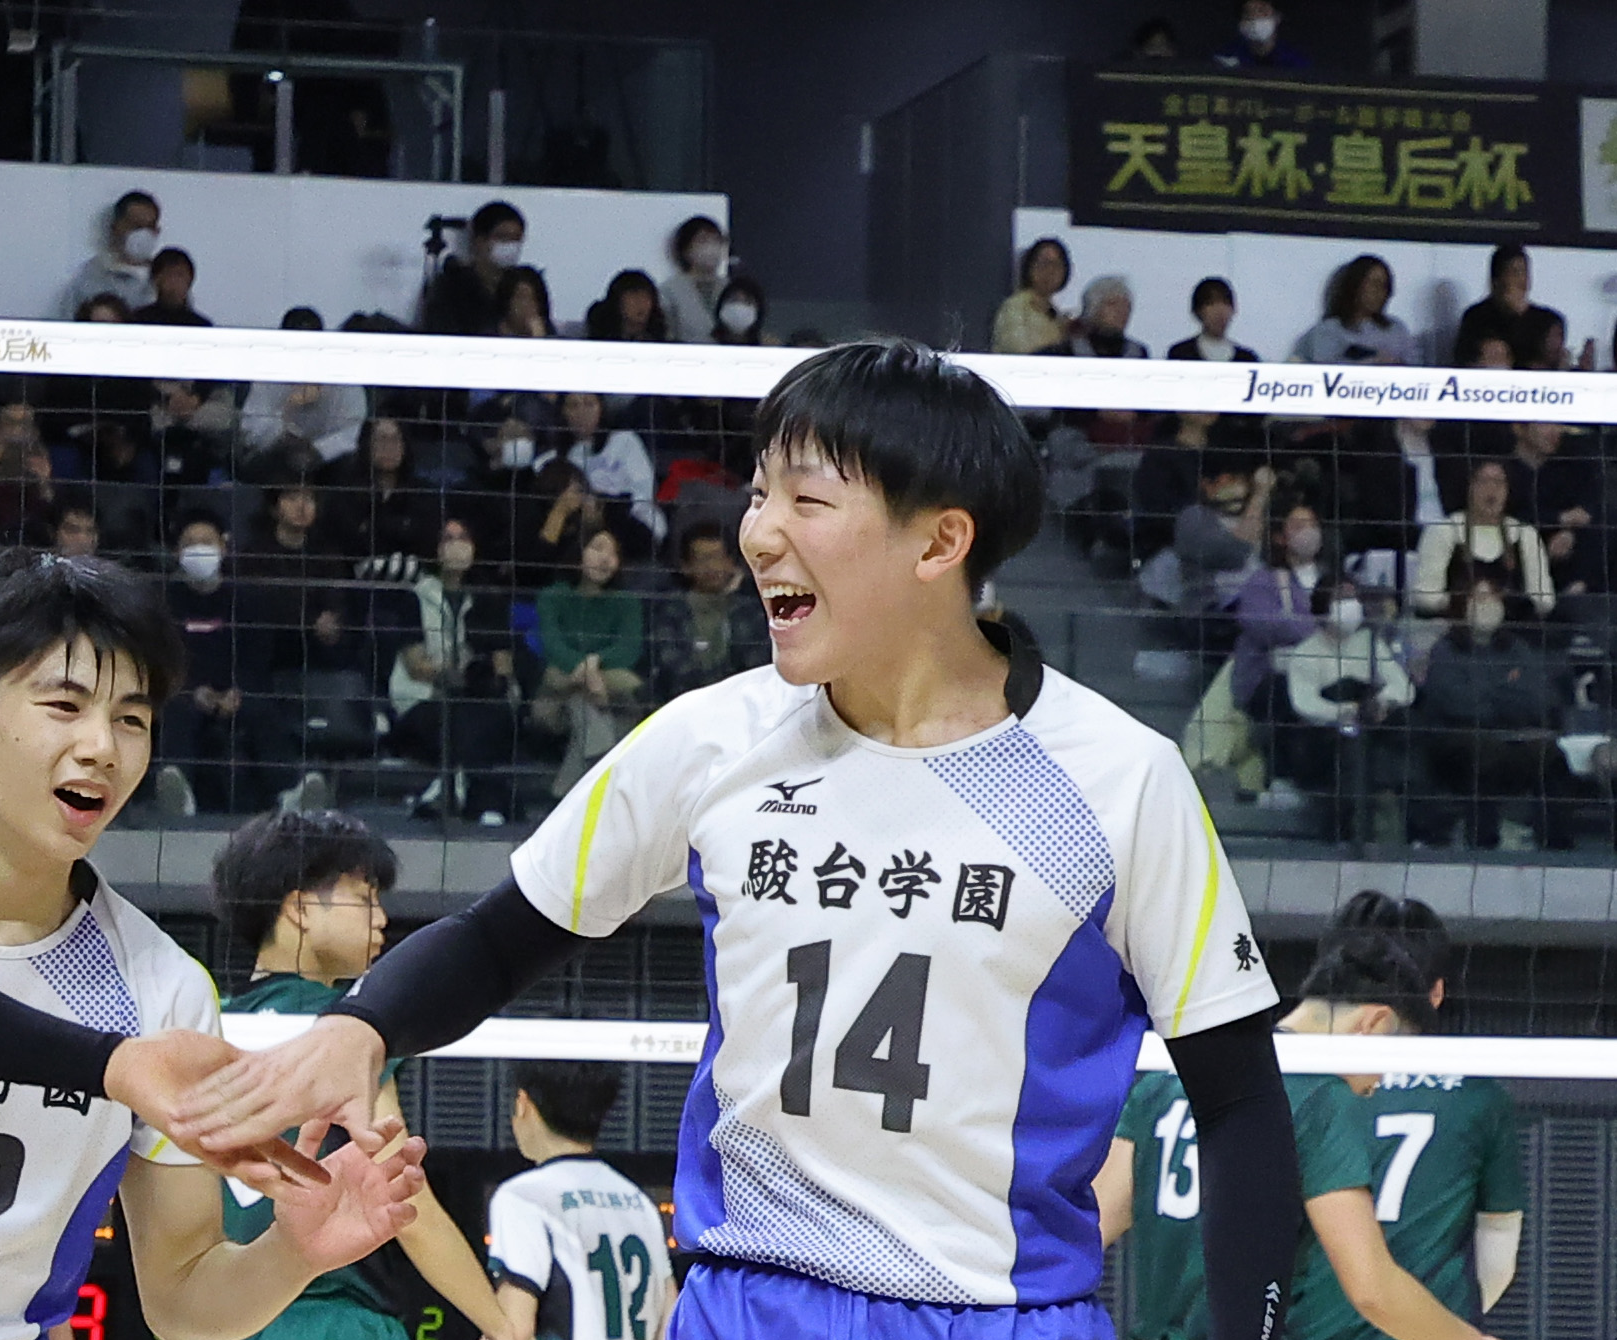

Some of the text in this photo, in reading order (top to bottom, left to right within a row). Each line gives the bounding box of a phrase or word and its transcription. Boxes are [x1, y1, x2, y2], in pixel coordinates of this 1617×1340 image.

[1242, 370, 1313, 402] Japan
[1437, 376, 1574, 405] Association
[741, 838, 1016, 932] 駿台学園
[779, 939, 931, 1133] 14
[1375, 1112, 1436, 1222] 7
